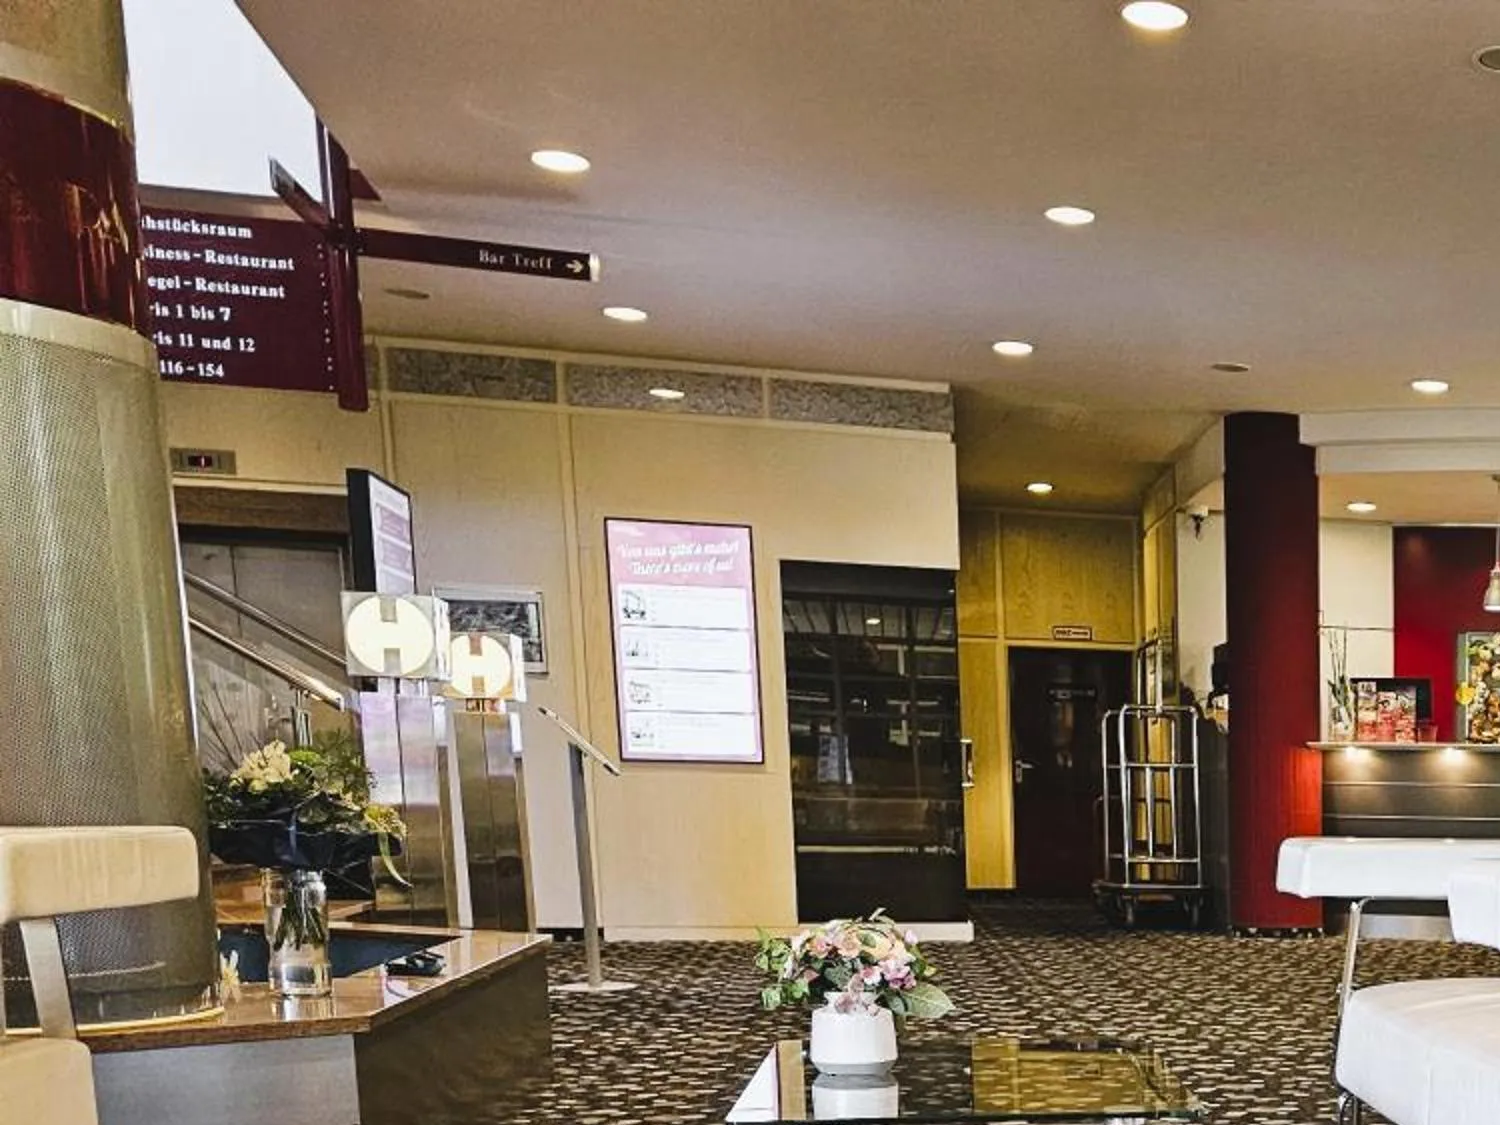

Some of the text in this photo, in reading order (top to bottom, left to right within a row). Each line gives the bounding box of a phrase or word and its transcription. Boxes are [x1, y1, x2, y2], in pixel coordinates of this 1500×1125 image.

[142, 215, 253, 239] hstücksraum
[479, 249, 505, 265] Bar
[147, 275, 286, 299] egel-Restaurant
[150, 302, 169, 318] is
[191, 305, 215, 321] bis
[219, 307, 231, 322] 7
[201, 336, 231, 351] und
[238, 338, 256, 353] 12
